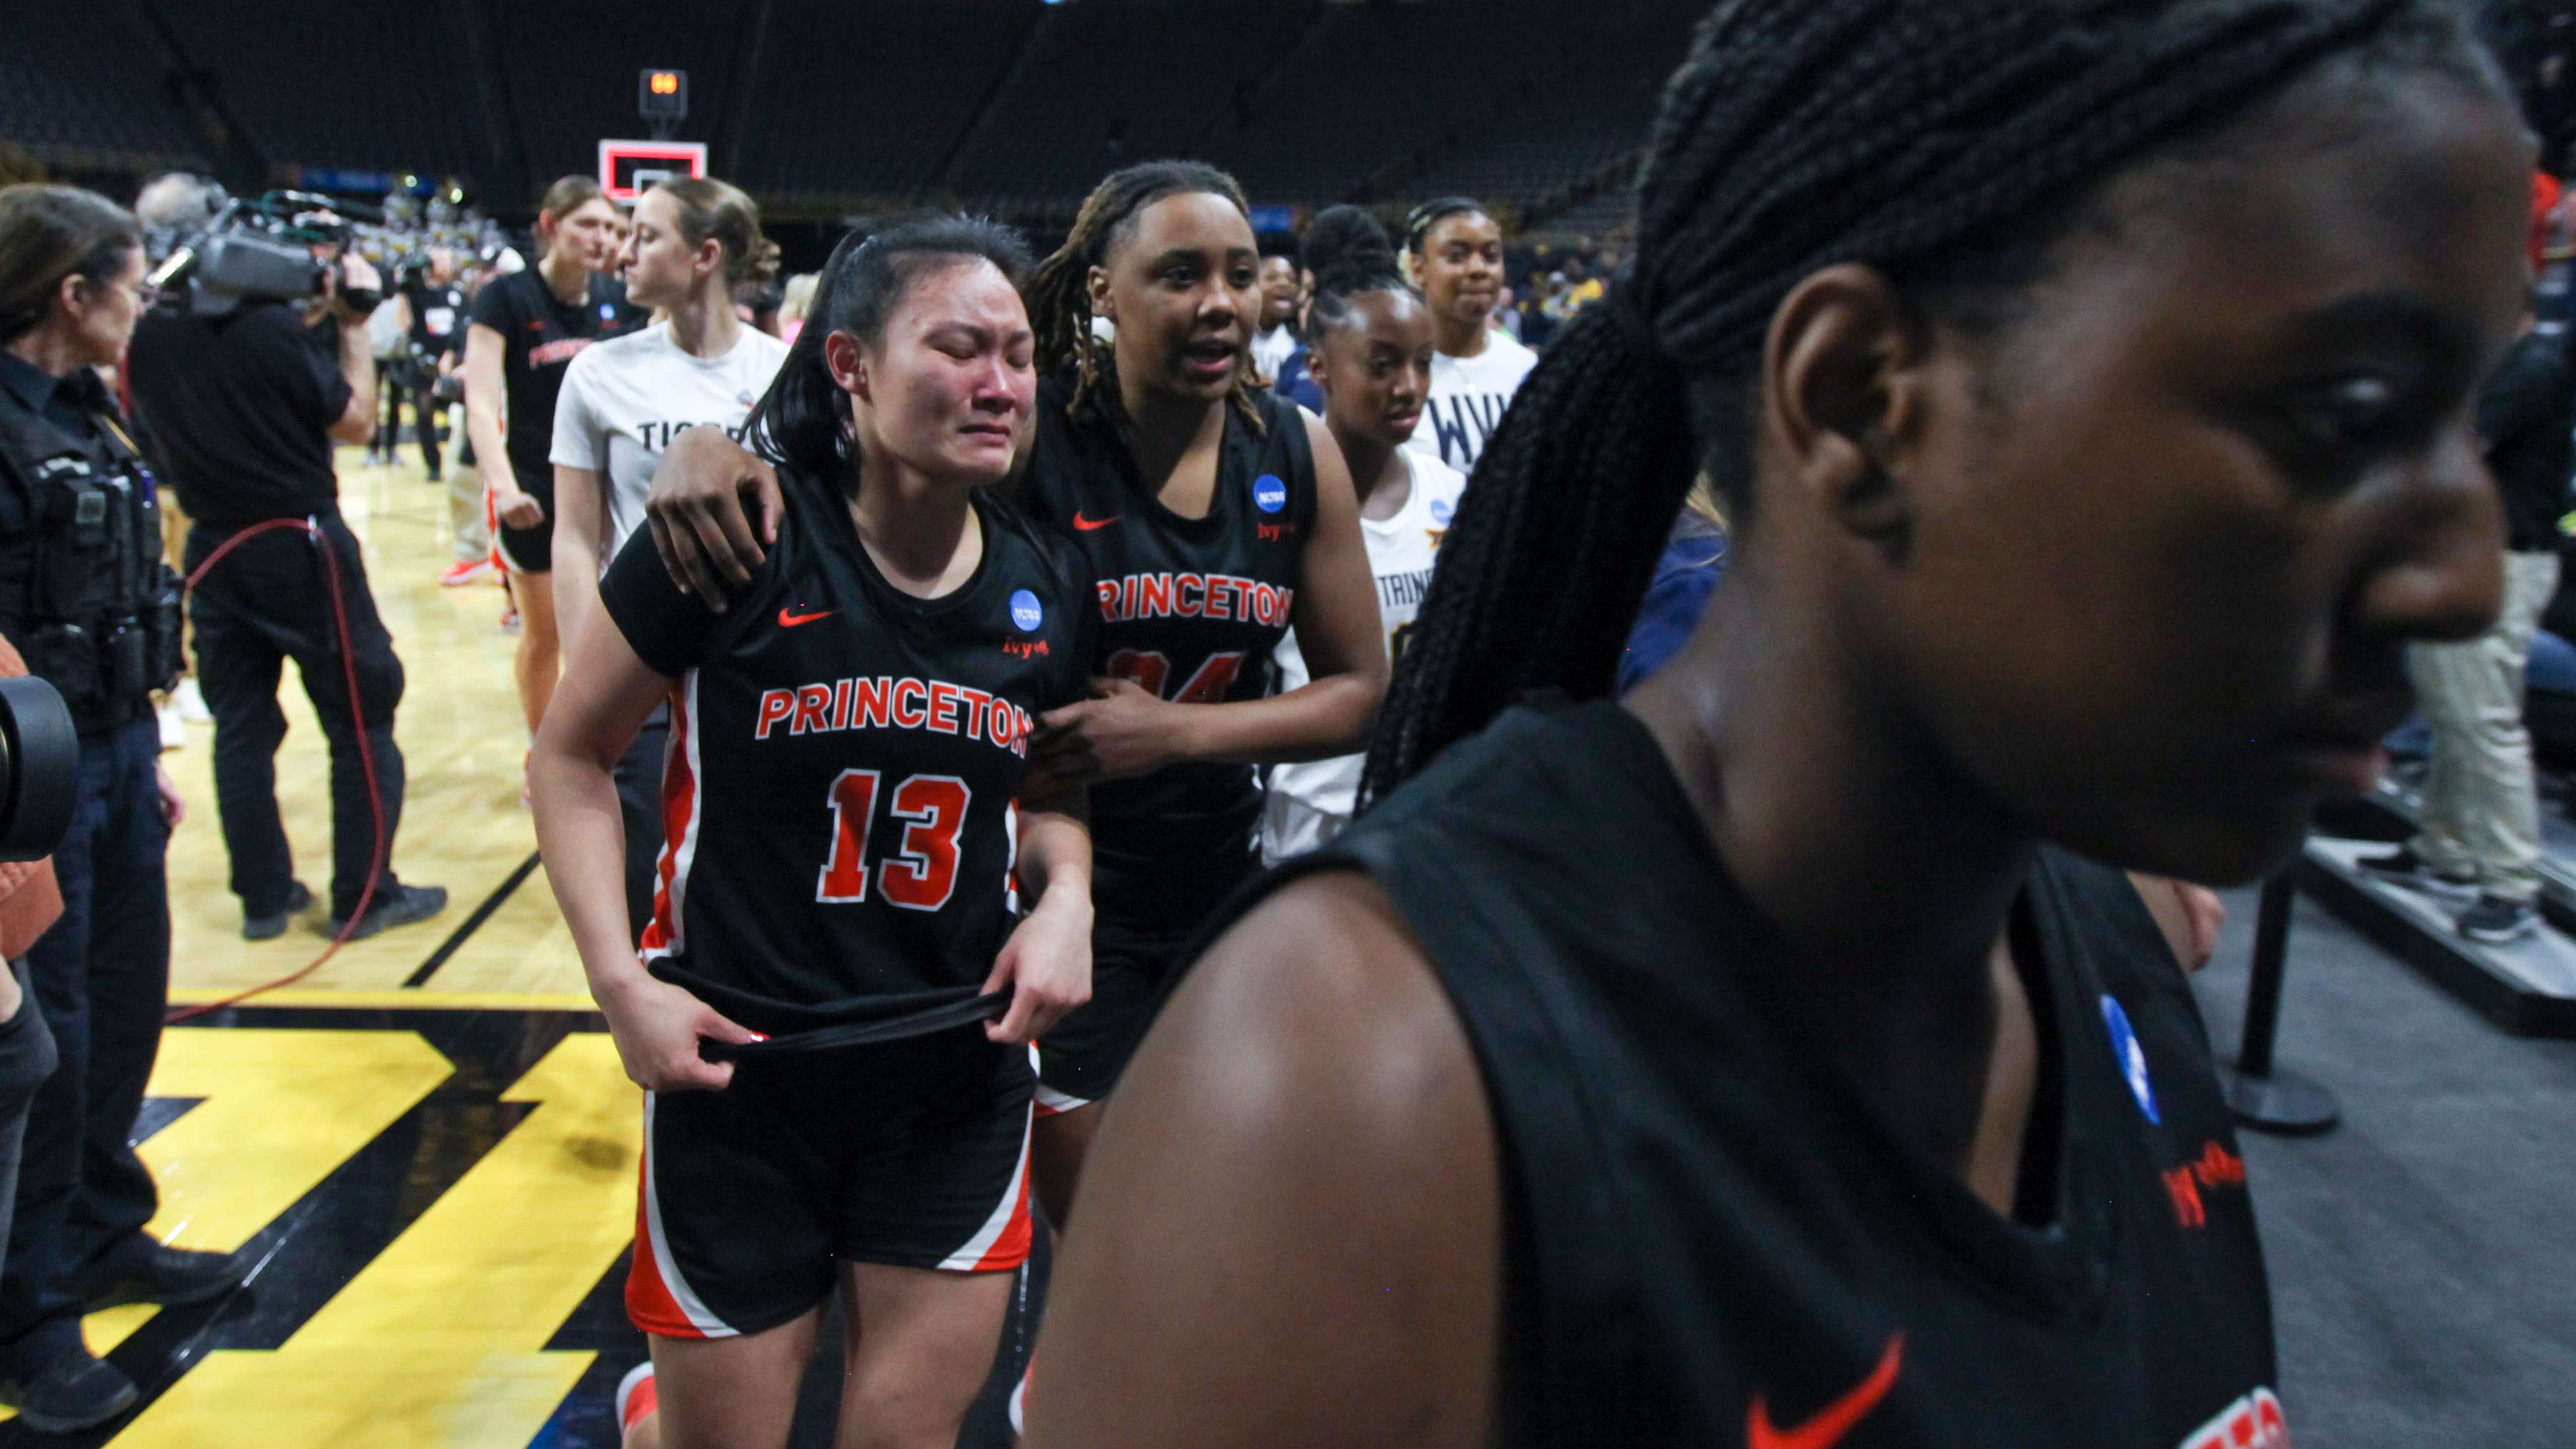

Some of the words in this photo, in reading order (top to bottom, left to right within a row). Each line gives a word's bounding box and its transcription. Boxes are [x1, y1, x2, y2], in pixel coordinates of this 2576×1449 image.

[1427, 394, 1503, 465] WV
[1096, 572, 1294, 628] RINCETON
[755, 676, 1034, 759] PRINCETON
[815, 768, 972, 912] 13
